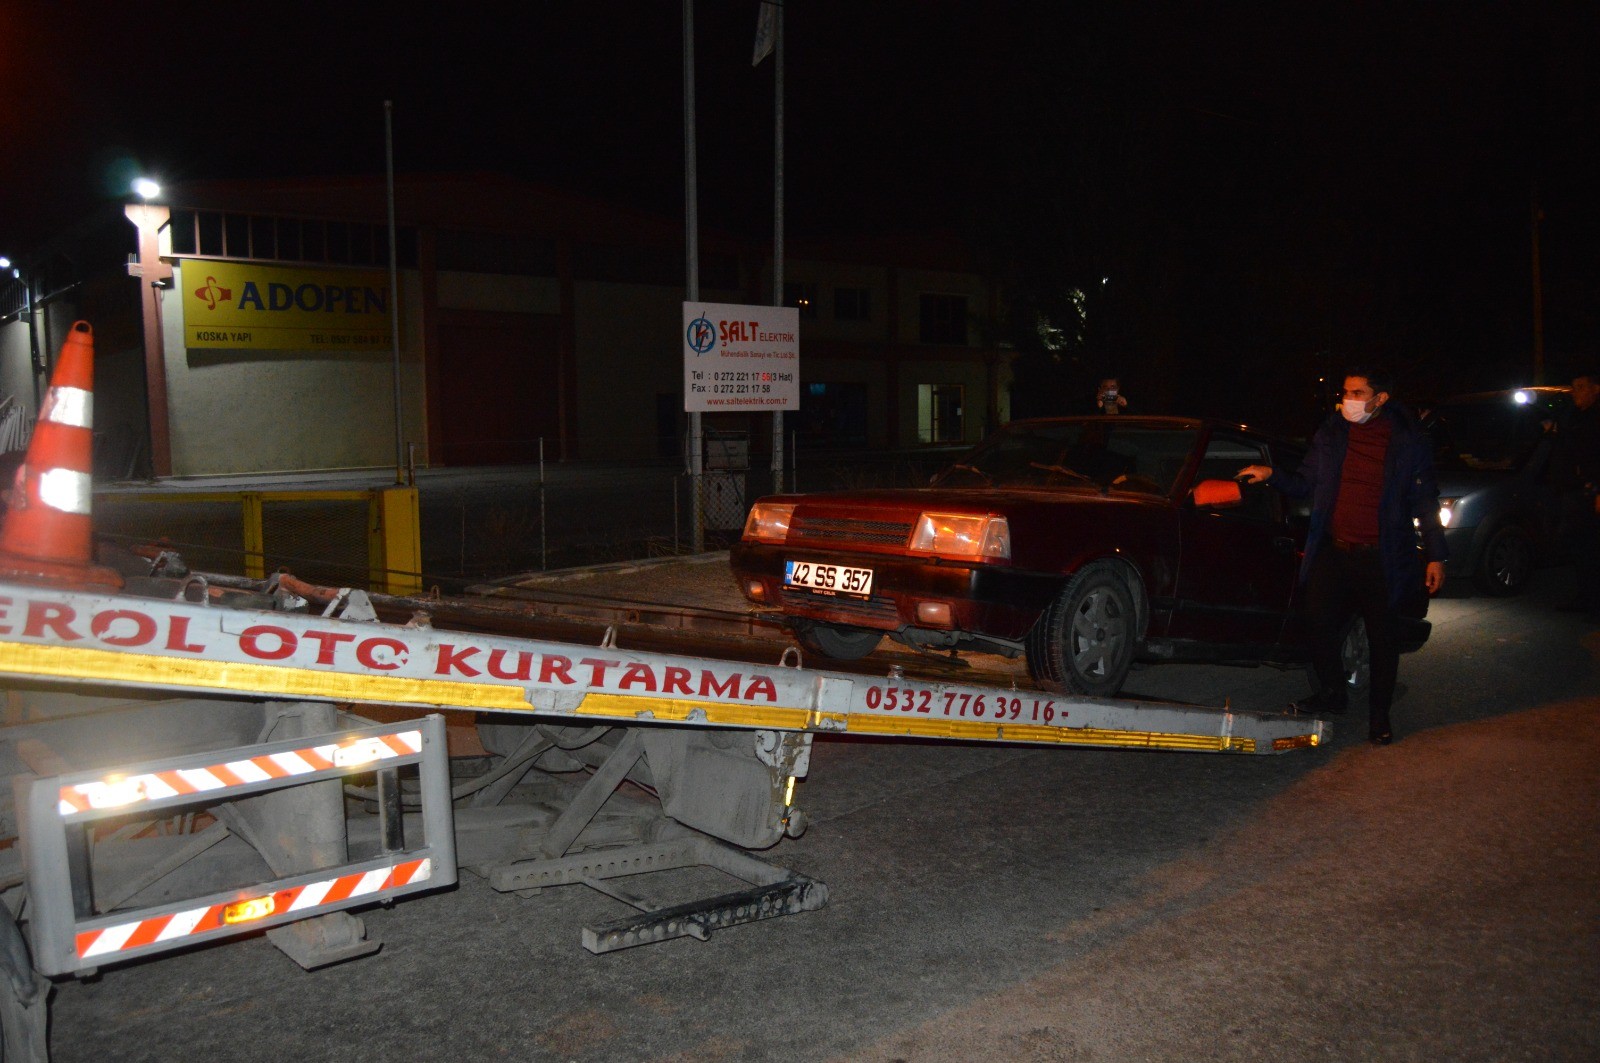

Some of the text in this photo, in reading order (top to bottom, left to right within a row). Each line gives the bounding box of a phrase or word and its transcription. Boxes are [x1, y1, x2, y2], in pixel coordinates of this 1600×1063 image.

[238, 281, 388, 314] ADOPEN
[196, 331, 252, 342] KOSKA YAPI
[719, 320, 759, 347] ŞALT
[691, 384, 706, 393] Fax
[714, 385, 719, 393] 0
[721, 385, 734, 393] 272
[736, 385, 749, 393] 221
[752, 385, 760, 393] 17
[762, 385, 771, 393] 58
[692, 371, 704, 380] Tel
[714, 372, 719, 381] 0
[721, 372, 734, 381] 272
[736, 372, 749, 381] 221
[752, 373, 760, 381] 17
[778, 373, 793, 383] Hat)
[706, 397, 788, 406] www.saltelektrik.com.tr
[793, 564, 871, 592] 42 SS 357
[434, 644, 779, 702] KURTARMA
[865, 685, 933, 714] 0532
[943, 692, 986, 718] 776
[994, 697, 1022, 721] 39
